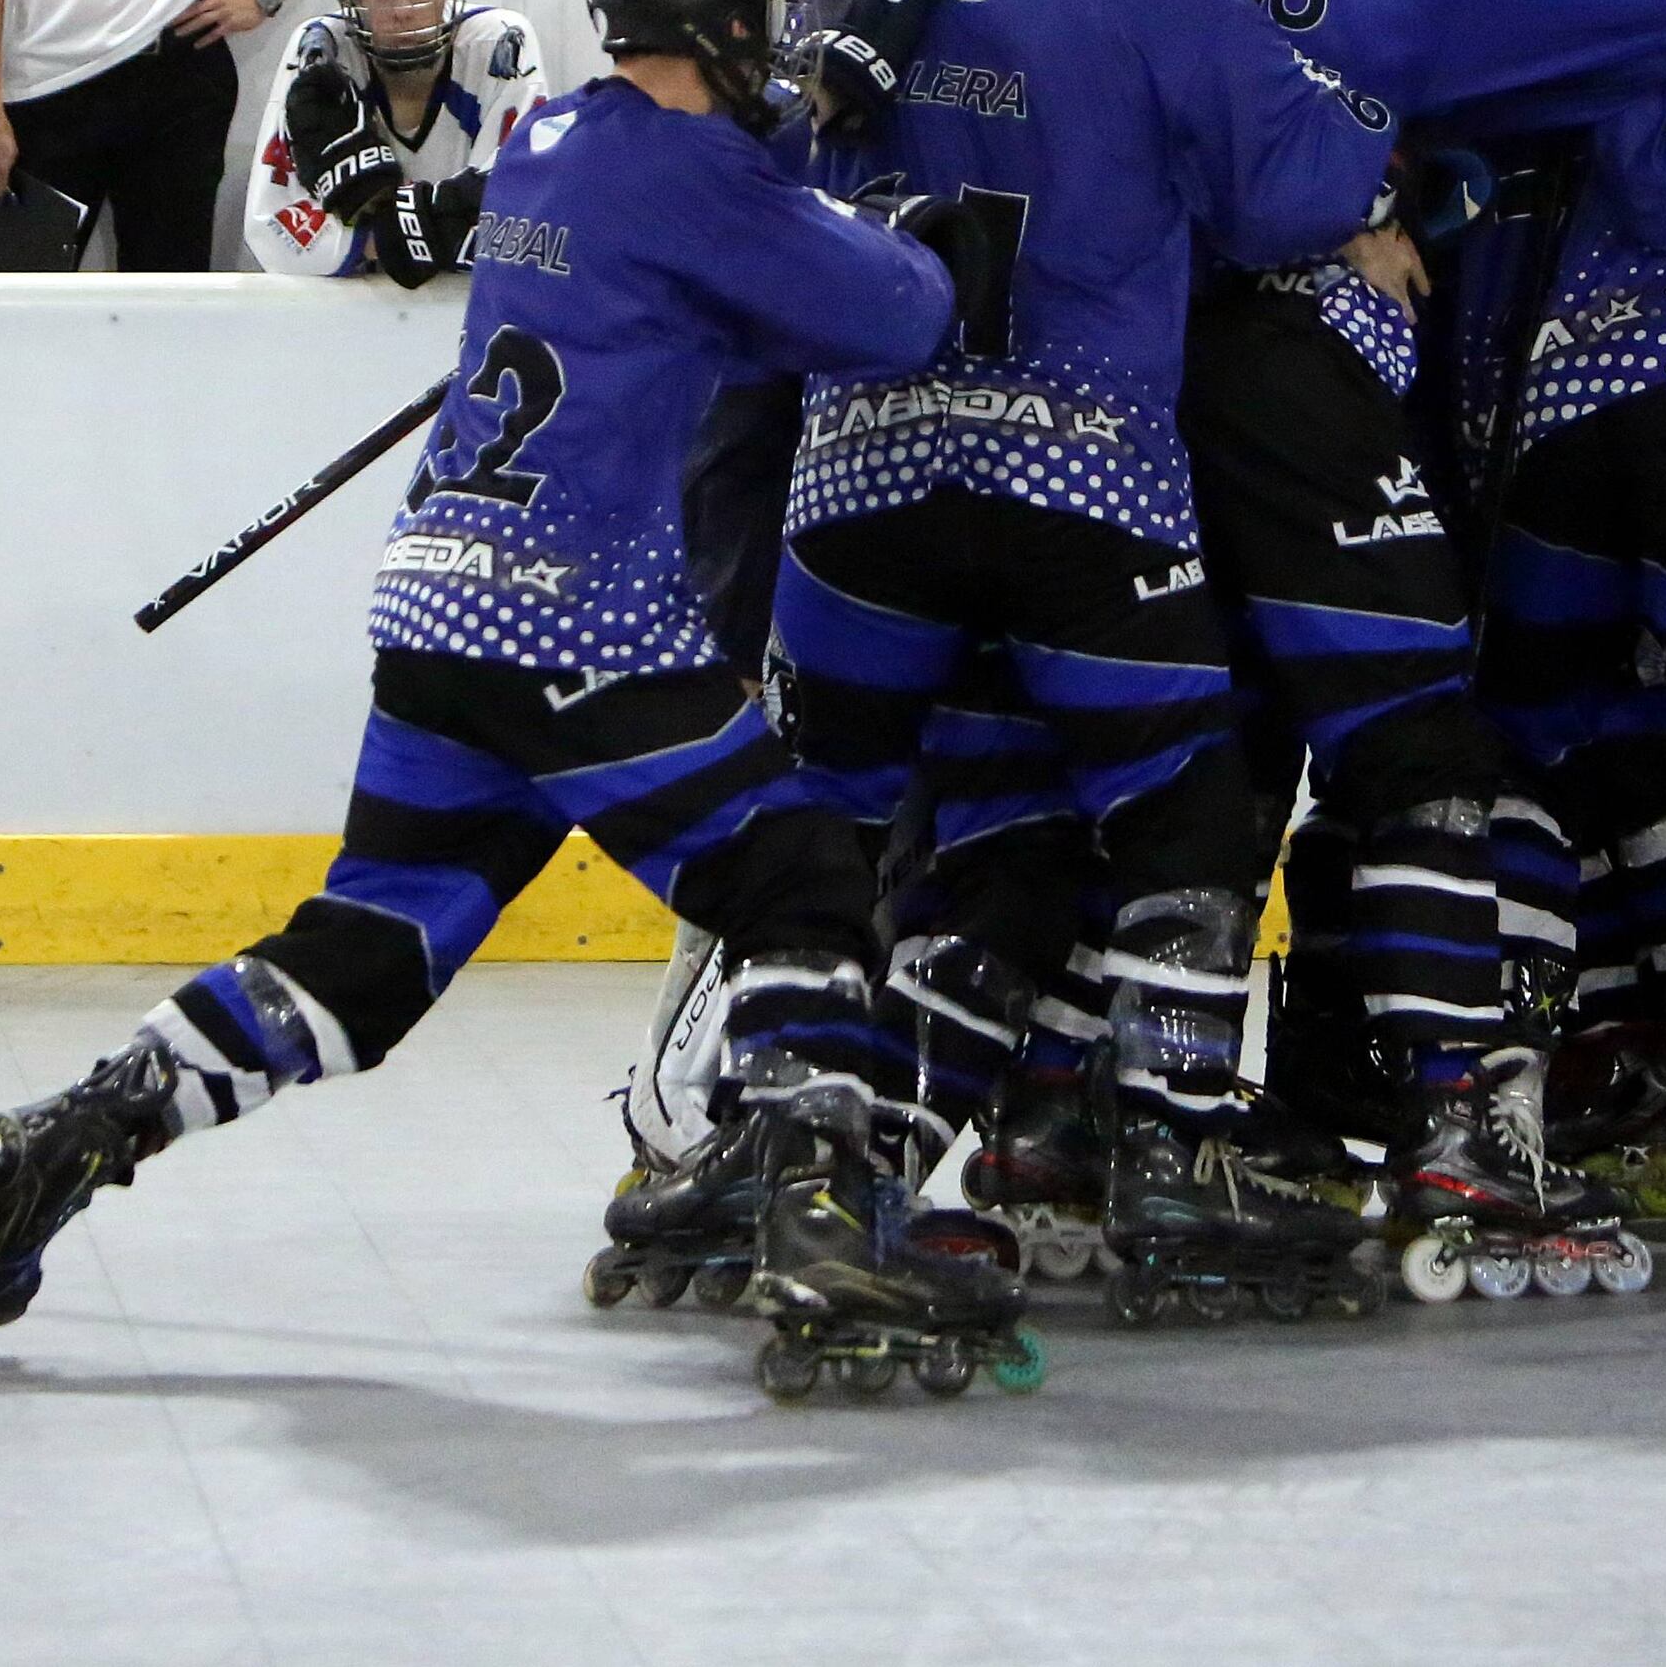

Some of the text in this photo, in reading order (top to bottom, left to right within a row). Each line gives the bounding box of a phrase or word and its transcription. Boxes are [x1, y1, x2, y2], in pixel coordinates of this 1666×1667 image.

[895, 59, 1027, 119] LERA
[312, 144, 397, 198] BAUE
[396, 183, 434, 263] BAU
[405, 323, 567, 514] 2
[187, 475, 323, 579] VAPOR
